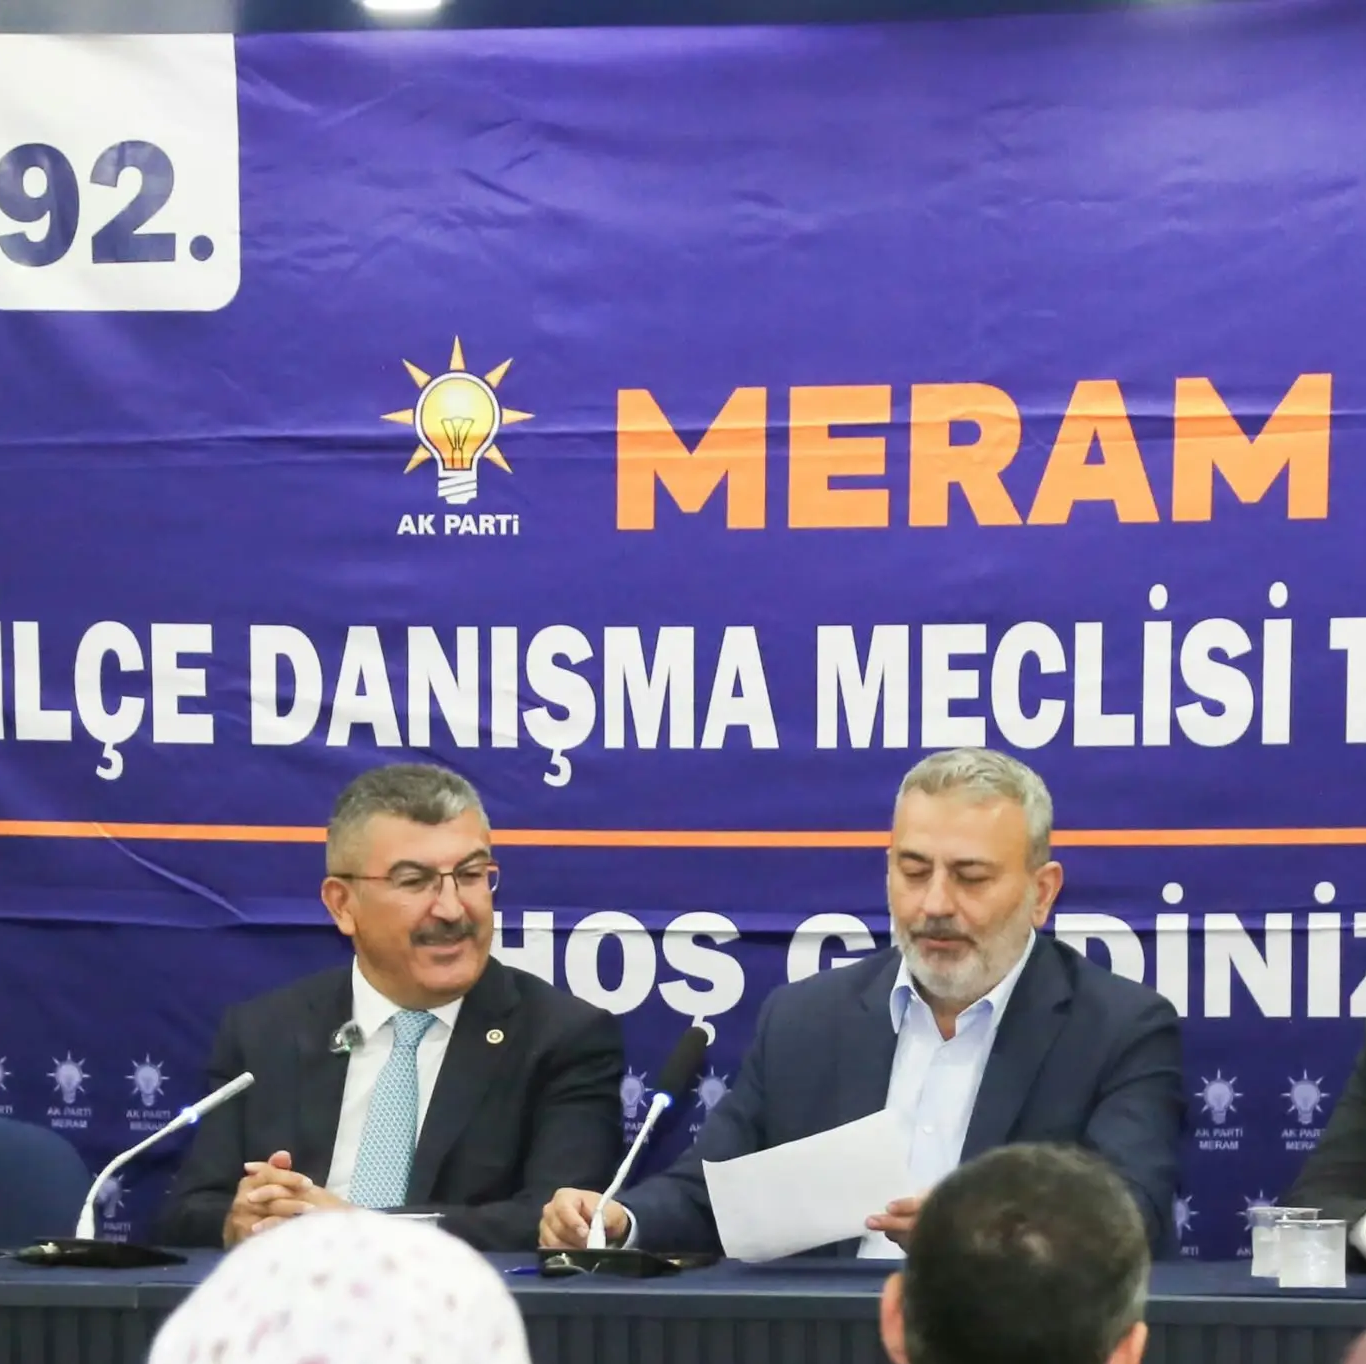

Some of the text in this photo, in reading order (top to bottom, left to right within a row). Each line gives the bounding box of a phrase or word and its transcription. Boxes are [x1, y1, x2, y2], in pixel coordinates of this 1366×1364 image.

[616, 373, 1332, 531] MERAM
[396, 514, 436, 535] AK
[249, 624, 780, 788] DANIŞMA
[816, 581, 1293, 750] MECLİSİ
[1285, 1141, 1317, 1150] MERA
